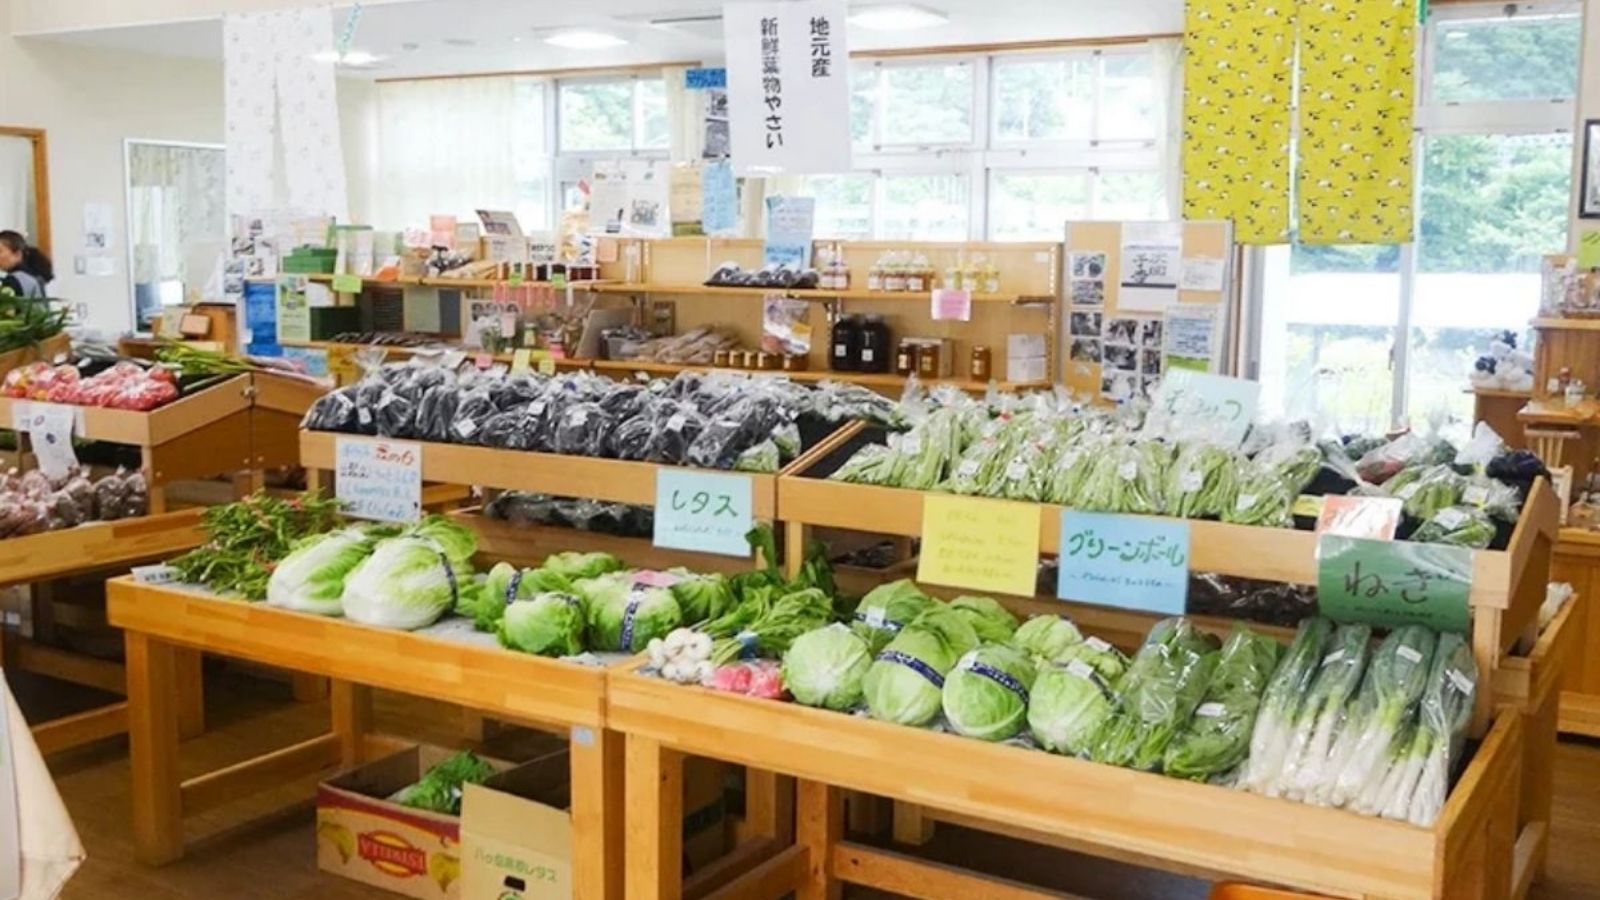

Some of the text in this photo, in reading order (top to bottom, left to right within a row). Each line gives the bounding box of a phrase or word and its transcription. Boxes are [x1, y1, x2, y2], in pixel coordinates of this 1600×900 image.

[810, 16, 831, 77] 地元産
[760, 17, 783, 149] 新鮮葉物やさい
[672, 489, 739, 517] レタス
[1069, 529, 1185, 567] グリーンボール
[1344, 560, 1450, 604] ねぎ
